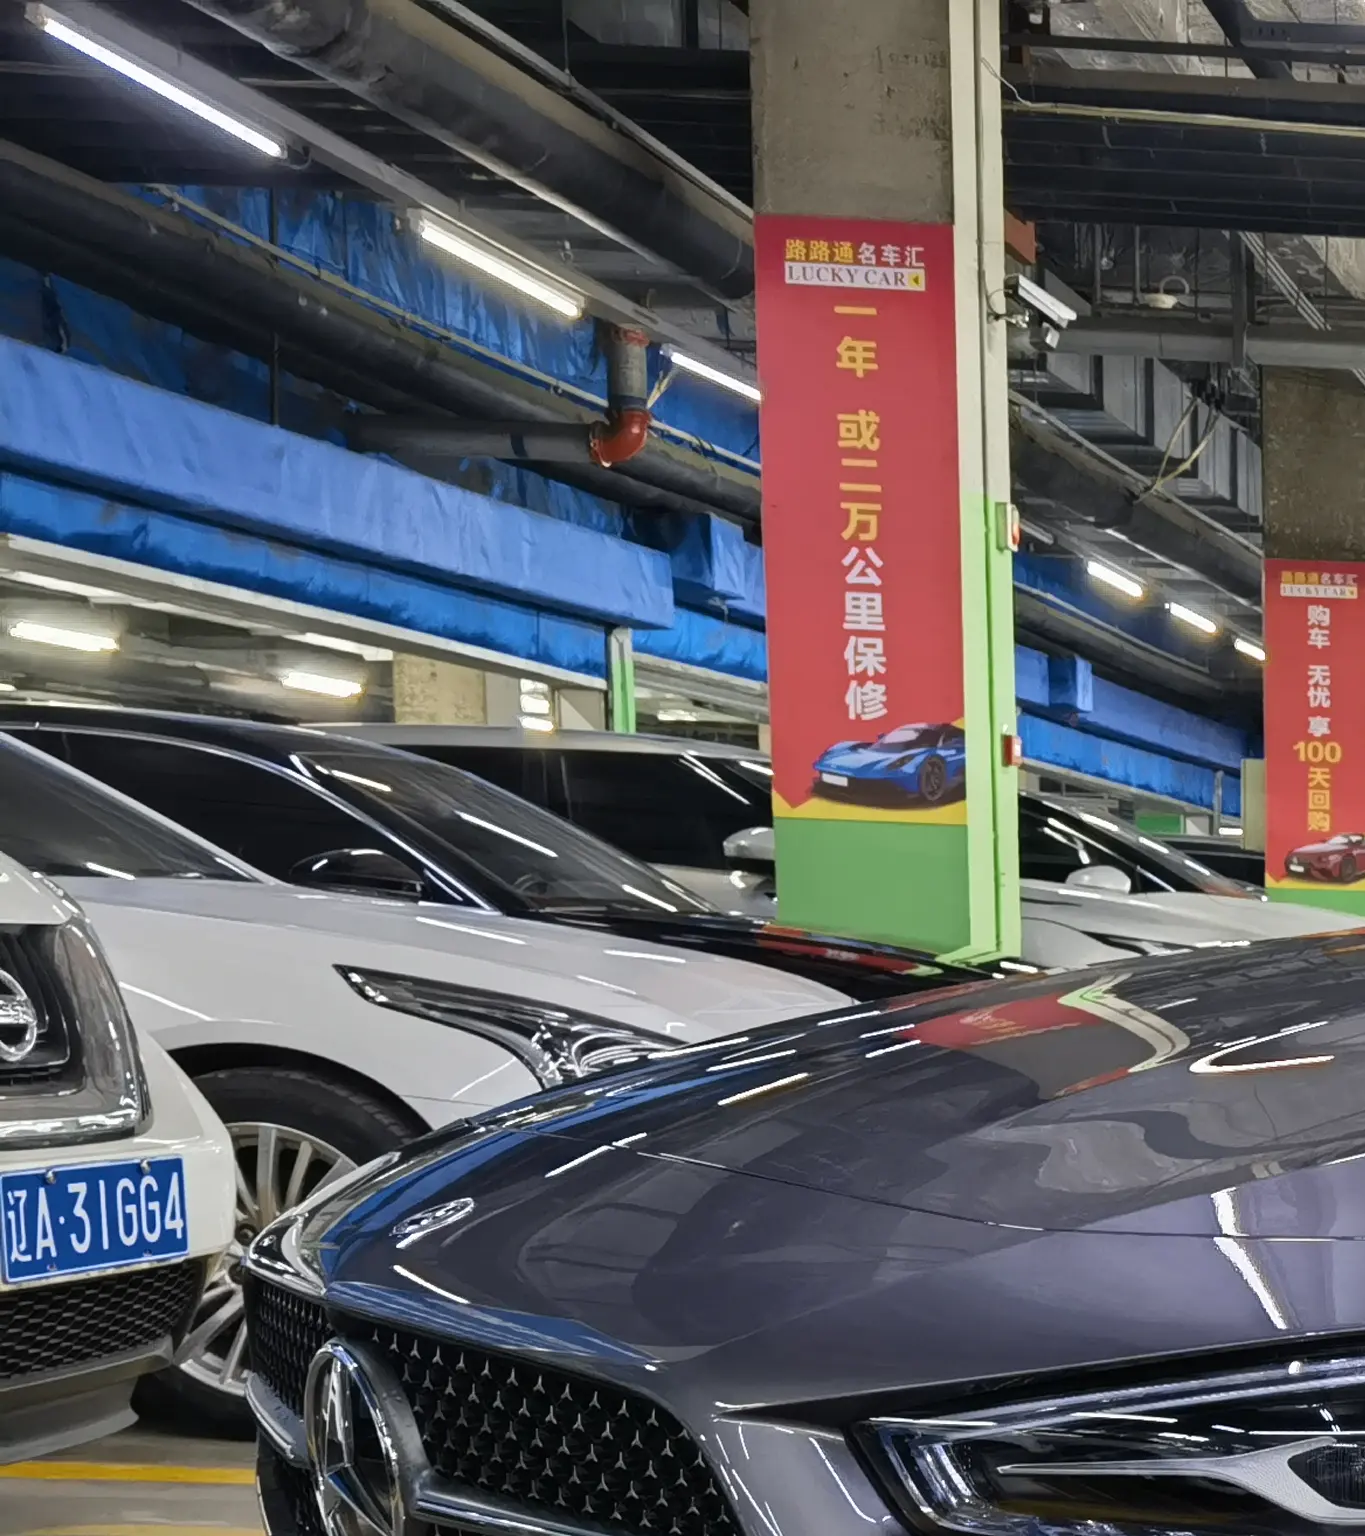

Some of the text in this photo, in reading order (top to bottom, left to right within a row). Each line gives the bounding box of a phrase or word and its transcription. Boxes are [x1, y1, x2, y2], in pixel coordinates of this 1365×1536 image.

[785, 238, 925, 268] 路路通名车汇
[788, 264, 908, 287] LUCKY CAR
